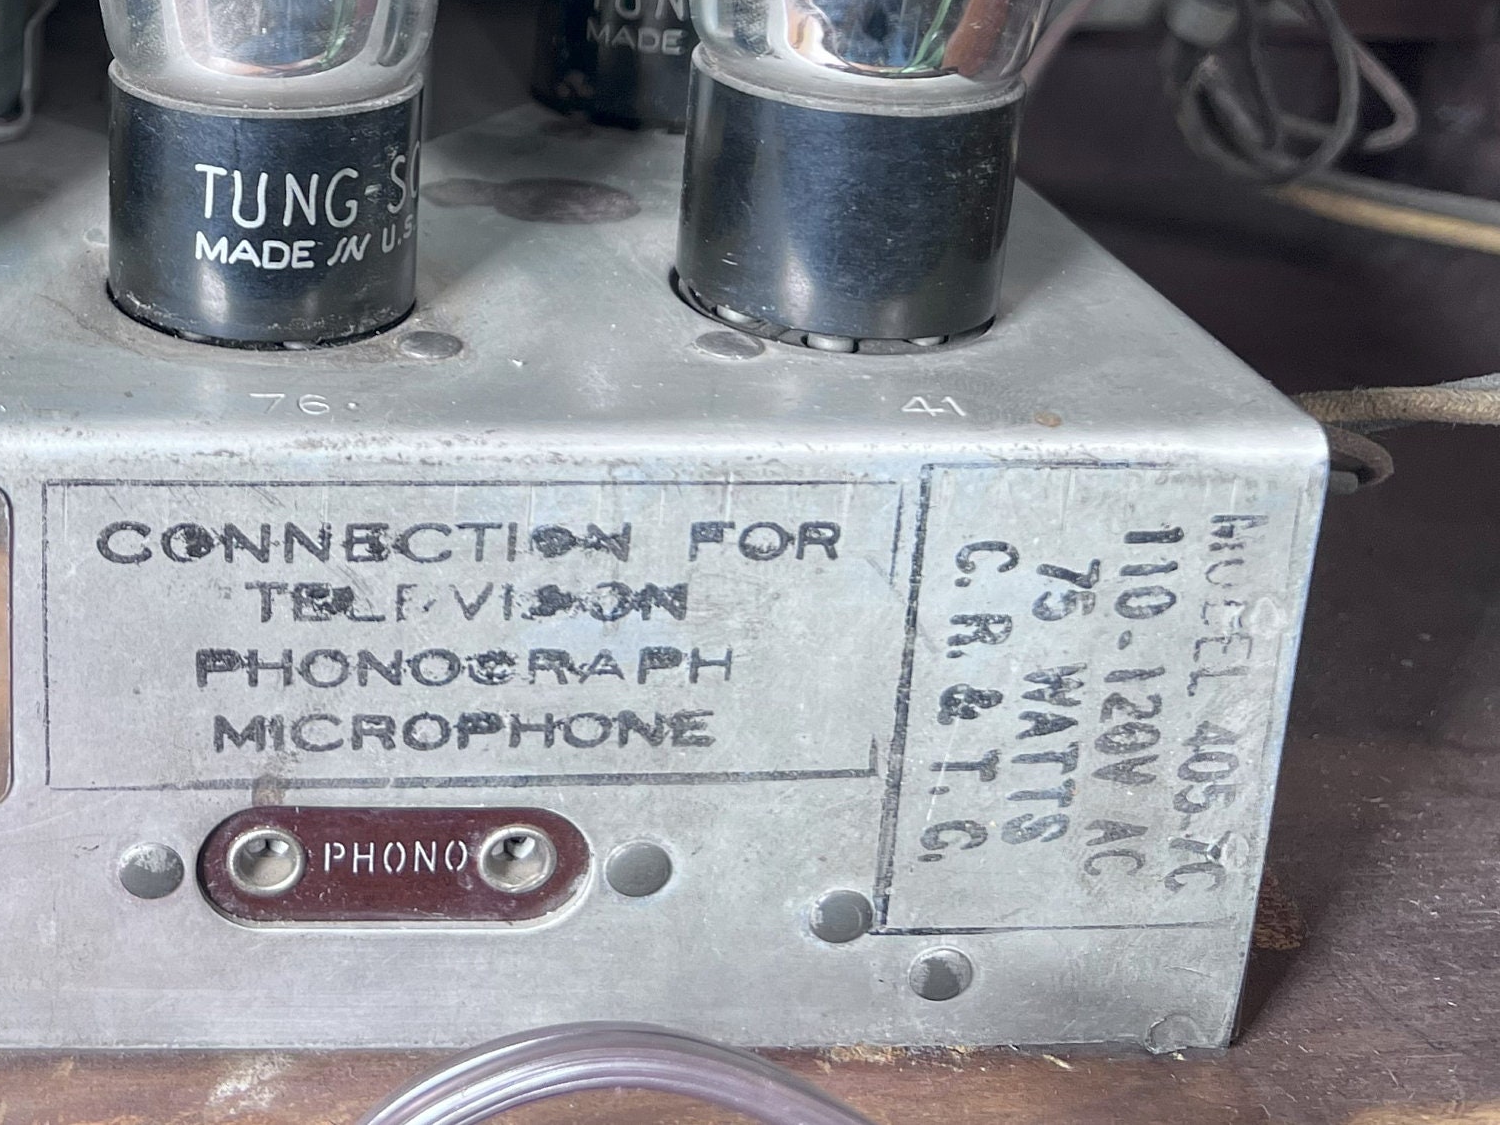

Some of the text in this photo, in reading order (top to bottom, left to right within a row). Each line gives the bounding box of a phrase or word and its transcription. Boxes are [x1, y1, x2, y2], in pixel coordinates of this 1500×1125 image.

[585, 15, 685, 56] MADE
[194, 230, 317, 271] MADE
[326, 233, 372, 267] IN
[900, 395, 967, 417] 41
[96, 520, 842, 564] CONNECTION FOR
[196, 645, 734, 689] PHONOGRAPH
[999, 557, 1102, 846] 75 WATTS
[212, 707, 717, 753] MICROPHONE
[322, 839, 470, 875] PHONO
[1082, 817, 1149, 876] AC
